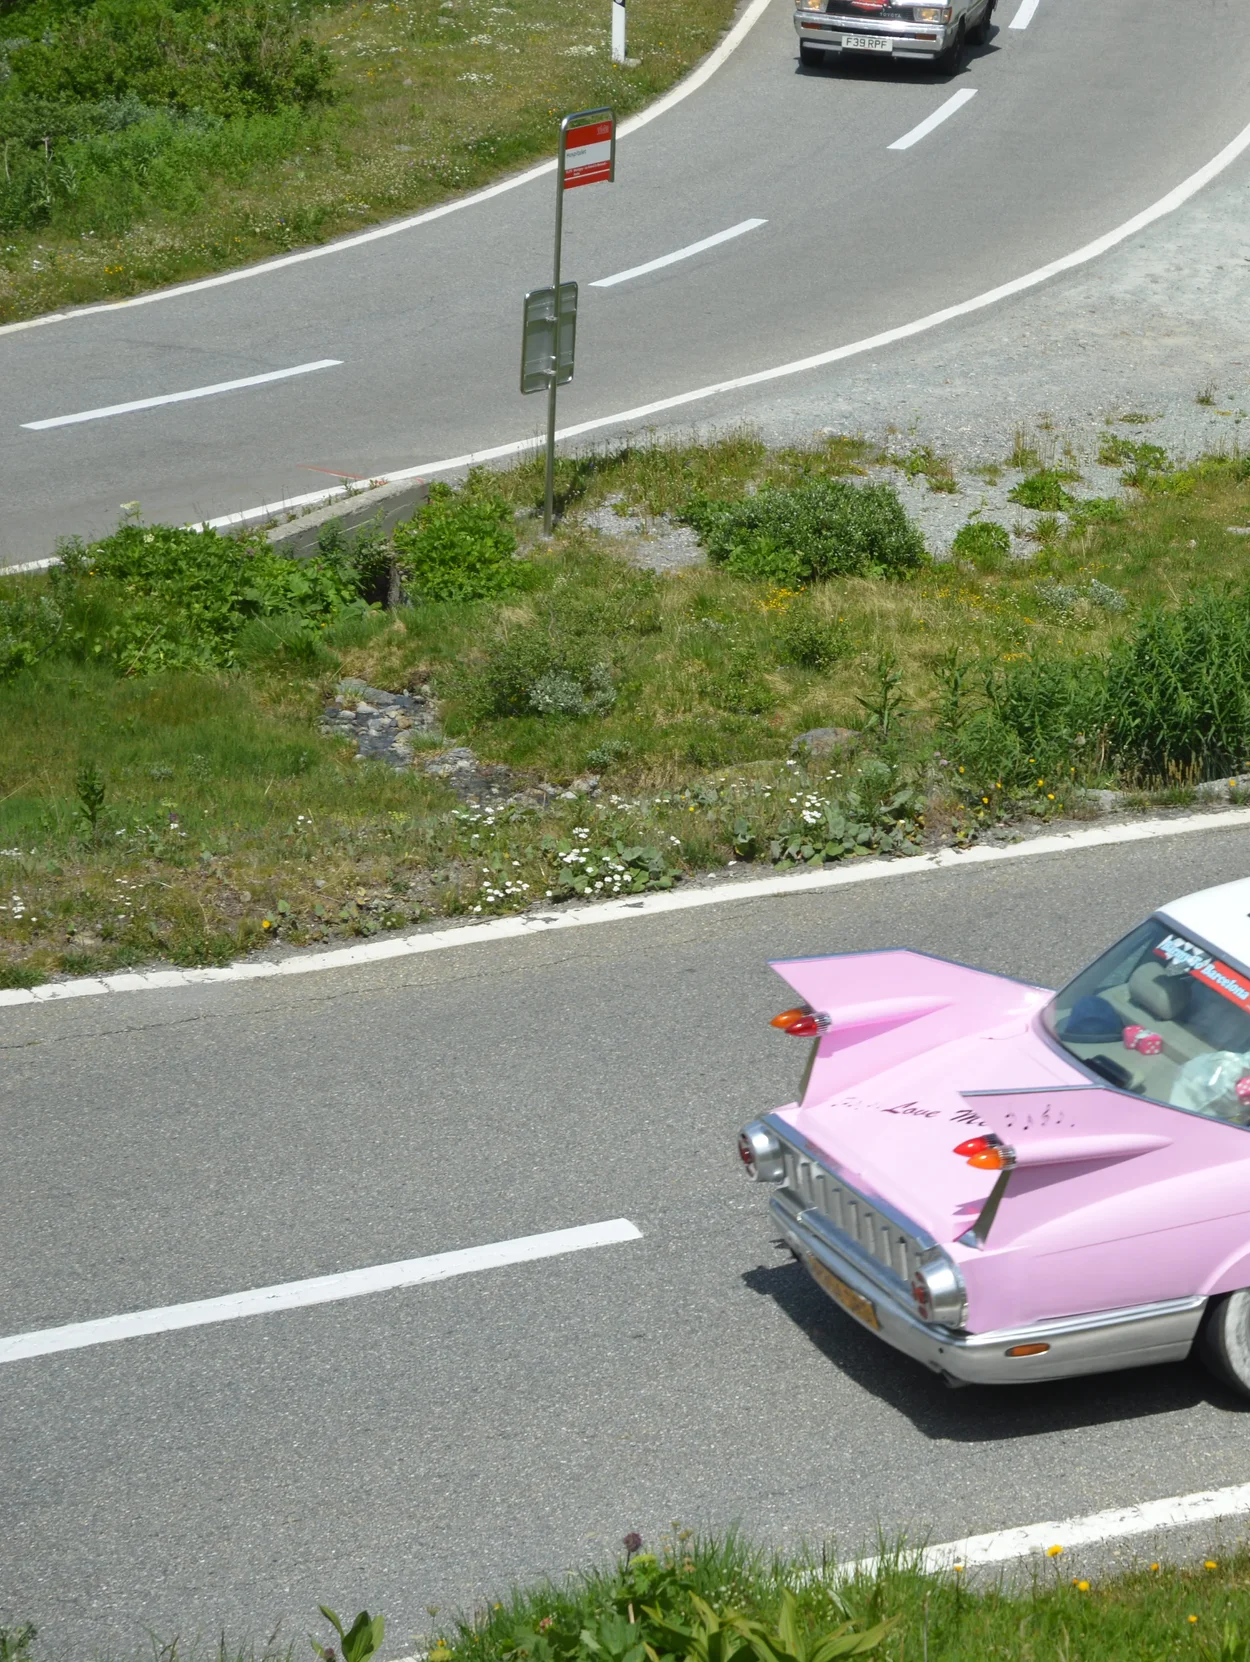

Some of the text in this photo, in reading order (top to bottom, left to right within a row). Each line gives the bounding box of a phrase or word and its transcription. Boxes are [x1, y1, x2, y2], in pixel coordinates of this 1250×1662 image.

[846, 38, 887, 49] F39 RPF
[1201, 963, 1250, 1000] Barcelona
[882, 1101, 941, 1119] Love
